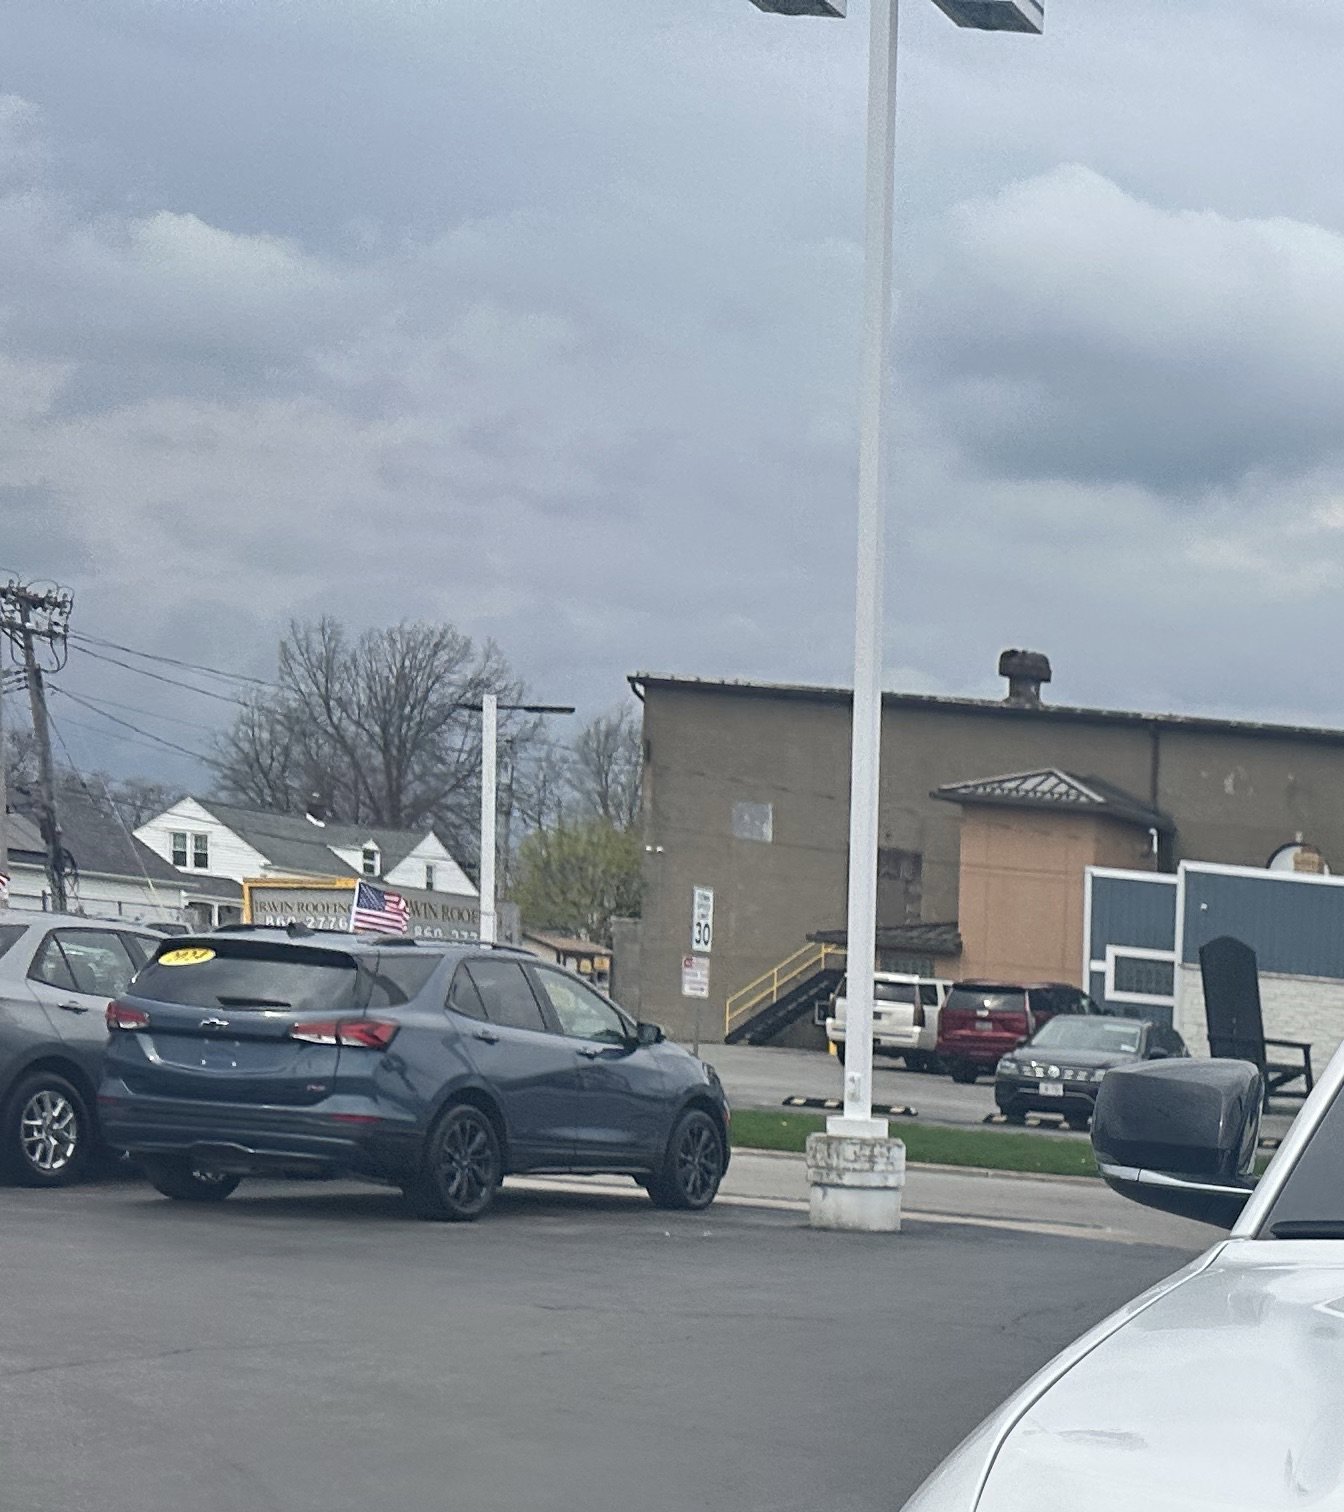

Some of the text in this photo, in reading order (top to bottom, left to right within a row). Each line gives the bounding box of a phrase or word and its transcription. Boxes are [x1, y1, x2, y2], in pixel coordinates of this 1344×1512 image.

[255, 900, 293, 913] IRWIN
[306, 916, 348, 930] 2776
[451, 929, 479, 941] 277
[695, 921, 710, 946] 30
